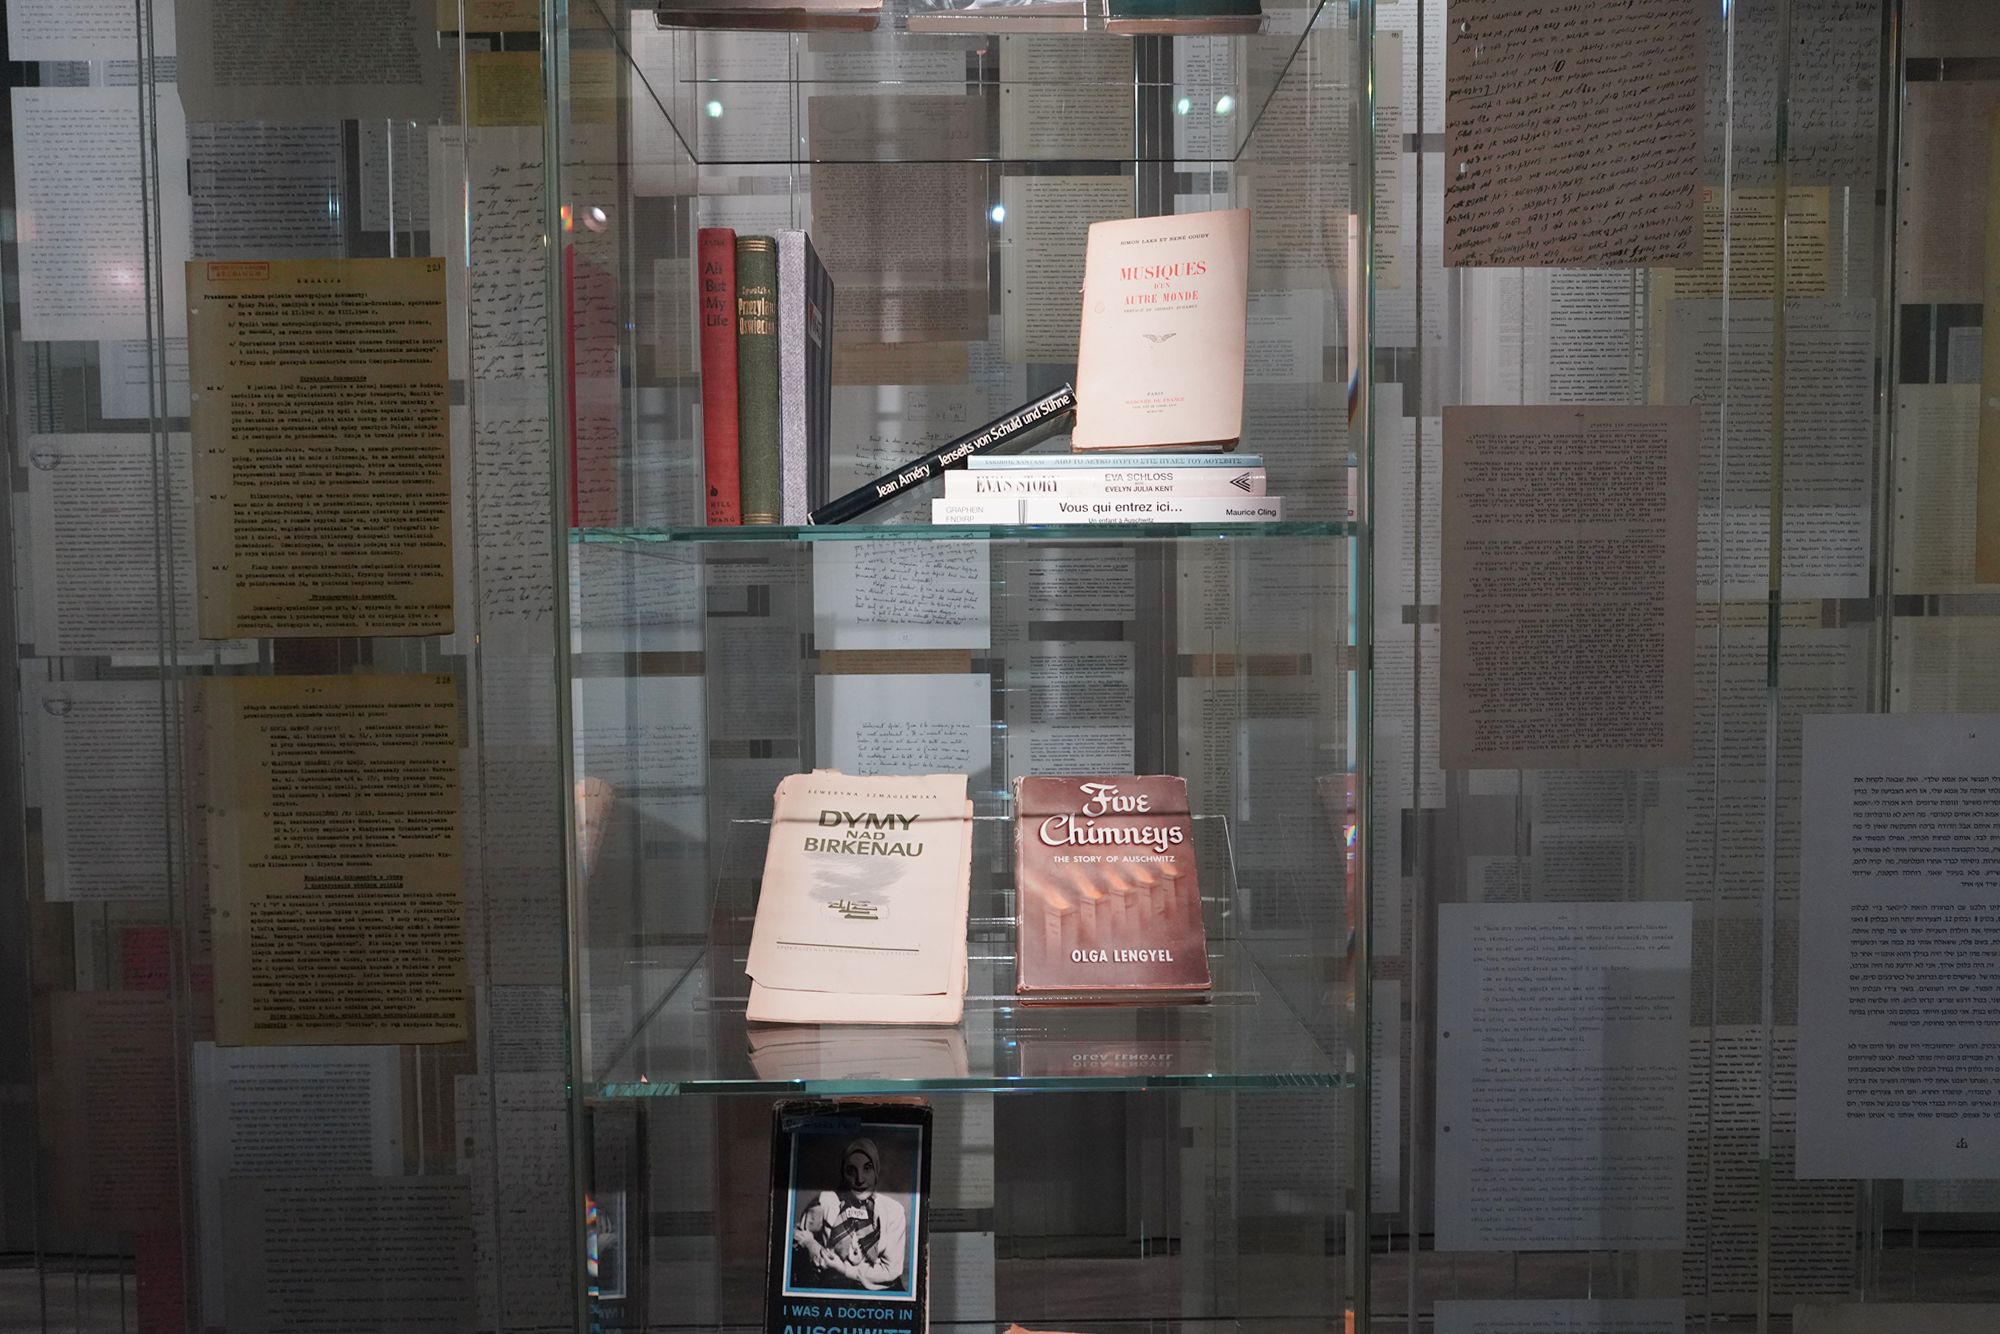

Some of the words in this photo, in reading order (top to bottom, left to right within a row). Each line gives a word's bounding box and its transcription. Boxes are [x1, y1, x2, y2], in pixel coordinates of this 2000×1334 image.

[705, 263, 722, 274] All
[1120, 260, 1206, 281] MUSIQUES
[706, 280, 726, 292] But
[706, 298, 726, 310] My
[1124, 294, 1158, 305] AUTRE
[1162, 290, 1200, 302] MONDE
[706, 314, 728, 327] Life
[876, 481, 899, 497] Jean
[899, 463, 930, 488] Améry
[938, 442, 975, 467] Jenseits
[973, 431, 993, 450] von
[990, 417, 1022, 442] Schuld
[1022, 408, 1042, 425] und
[1039, 394, 1071, 416] Sühne
[1104, 473, 1124, 482] EVA
[1126, 472, 1174, 481] SCHLOSS
[1059, 502, 1088, 512] Vous
[1092, 502, 1111, 514] qui
[1115, 502, 1152, 512] entrez
[1156, 501, 1182, 512] ici...
[1258, 508, 1277, 517] Cling
[1080, 782, 1152, 818] Five
[818, 810, 920, 830] DYMY
[846, 830, 886, 840] NAD
[1039, 814, 1184, 854] Chimneys
[804, 837, 924, 857] BIRKENAU
[1072, 949, 1108, 962] OLGA
[1114, 949, 1174, 962] LENGYEL
[784, 1305, 787, 1316] I
[792, 1306, 820, 1318] WAS
[824, 1306, 833, 1318] A
[838, 1308, 894, 1320] DOCTOR
[900, 1309, 912, 1321] IN
